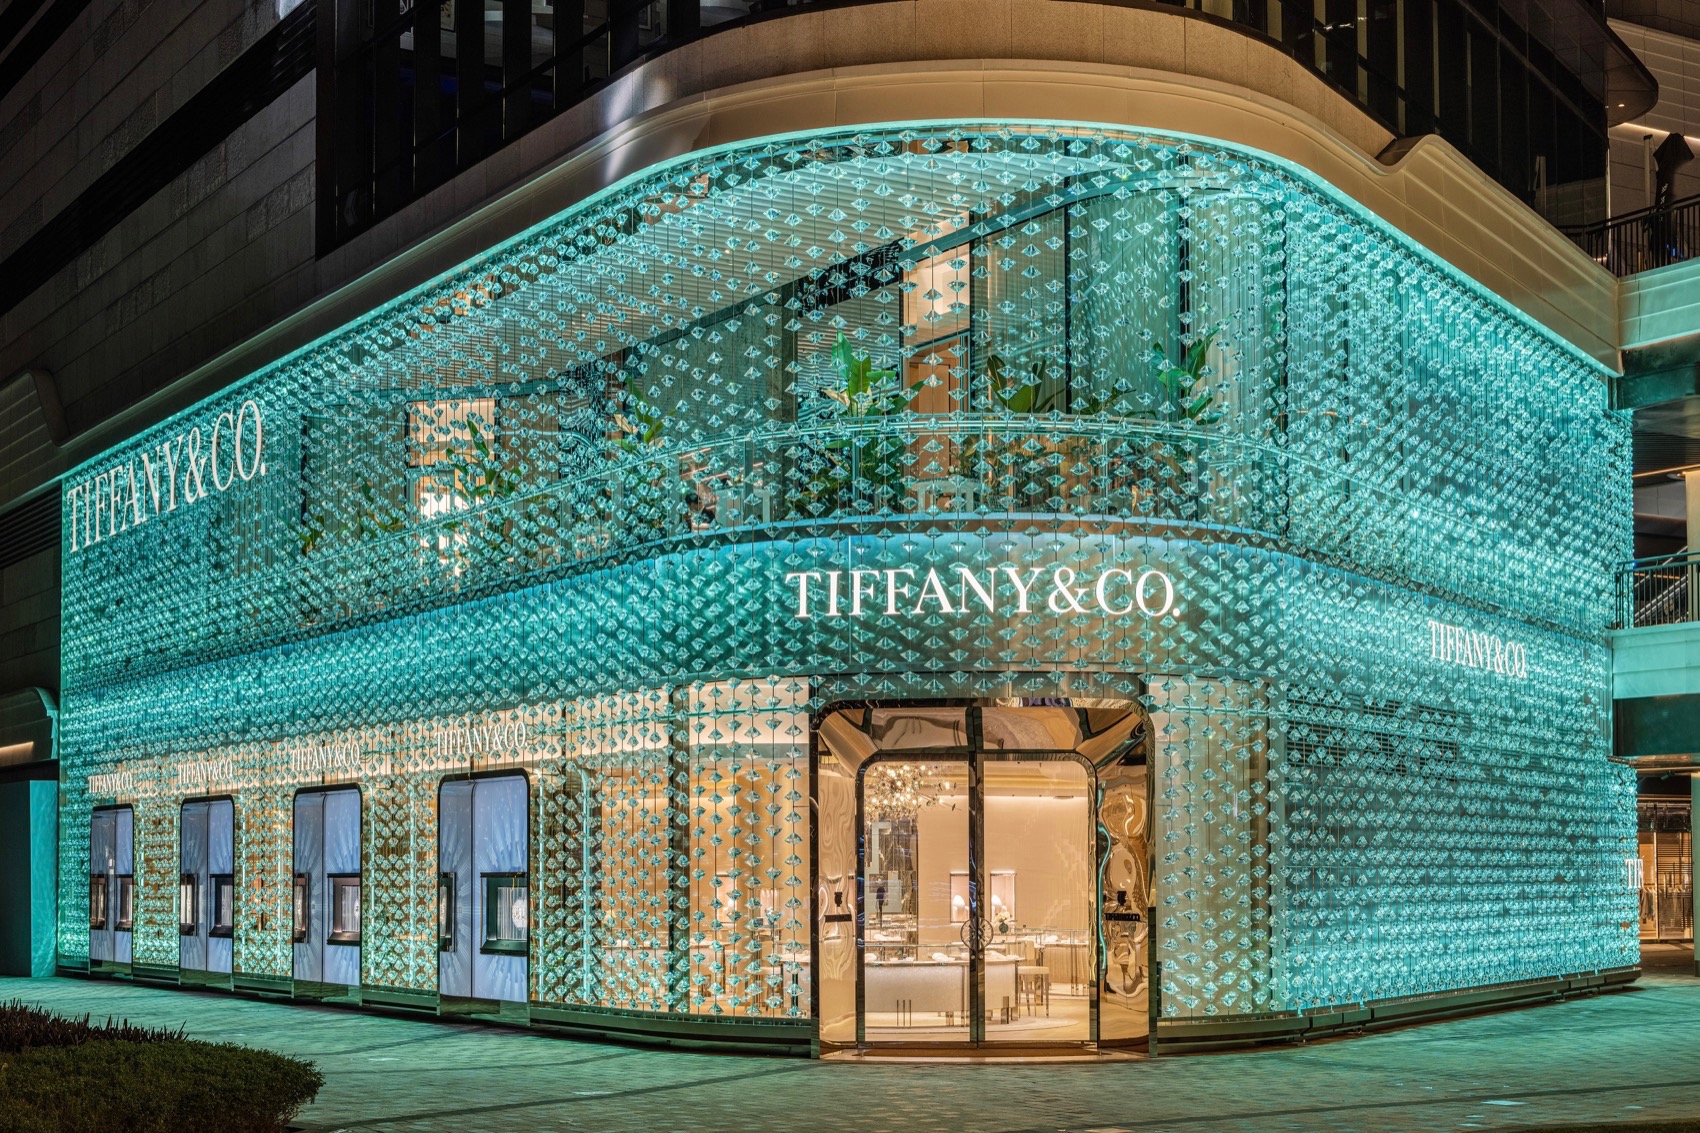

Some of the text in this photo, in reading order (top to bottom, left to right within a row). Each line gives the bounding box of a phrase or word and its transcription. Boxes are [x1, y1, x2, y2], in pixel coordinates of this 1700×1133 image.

[66, 400, 265, 553] TIFFANY&CO.
[785, 567, 1181, 618] TIFFANY&CO.
[433, 721, 528, 756] TIFFANY&CO.
